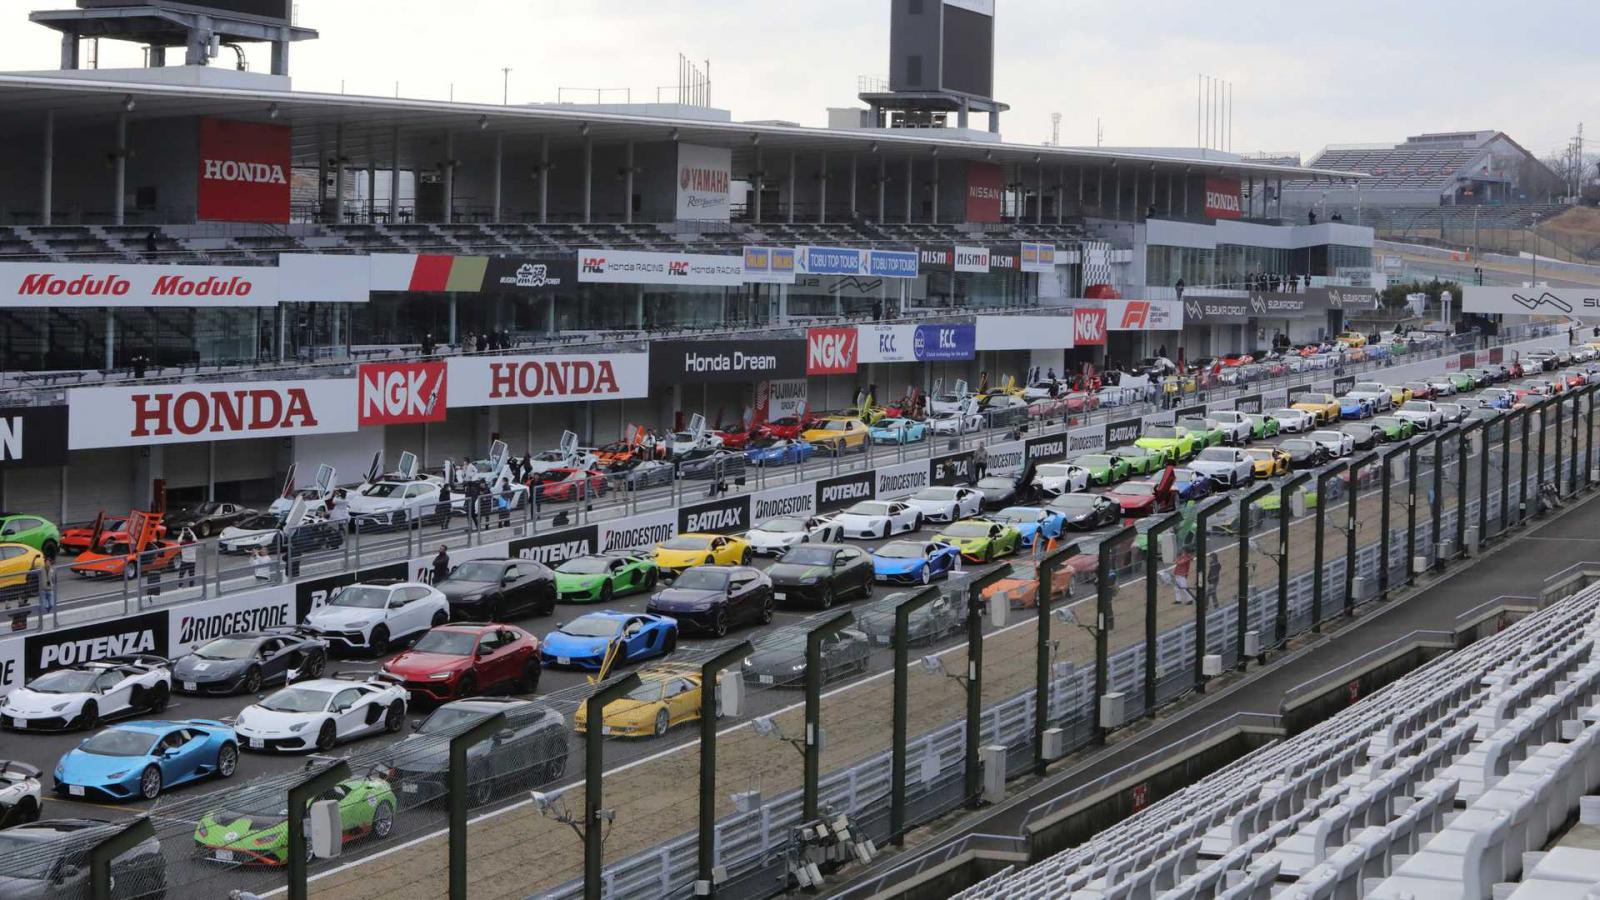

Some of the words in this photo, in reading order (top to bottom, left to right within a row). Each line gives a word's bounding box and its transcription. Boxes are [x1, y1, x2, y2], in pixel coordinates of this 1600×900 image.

[204, 160, 287, 184] HONDA
[691, 168, 728, 193] YAMAHA
[969, 185, 999, 199] NISSAN
[1206, 192, 1239, 211] HONDA
[583, 257, 606, 273] HRC
[668, 261, 688, 276] HRC
[810, 254, 827, 267] TOBU
[828, 255, 840, 268] TOP
[840, 255, 858, 269] TOURS
[18, 273, 130, 296] Modulo
[152, 275, 252, 296] Modulo
[1205, 305, 1227, 315] SUZUKA
[1075, 312, 1099, 341] NGK
[685, 352, 731, 372] Honda
[733, 351, 776, 371] Dream
[809, 333, 847, 369] NGK
[489, 360, 620, 399] HONDA
[363, 368, 428, 418] NGK
[770, 383, 806, 399] FUJIMAKI
[131, 388, 318, 437] HONDA
[1029, 441, 1063, 458] POTENZA
[1069, 434, 1104, 451] BRIDGESTONE
[821, 481, 871, 503] POTENZA
[879, 471, 927, 493] BRIDGESTONE
[755, 494, 812, 519] BRIDGESTONE
[605, 522, 673, 551] BRIDGESTONE
[179, 603, 288, 645] BRIDGESTONE
[40, 629, 155, 669] POTENZA
